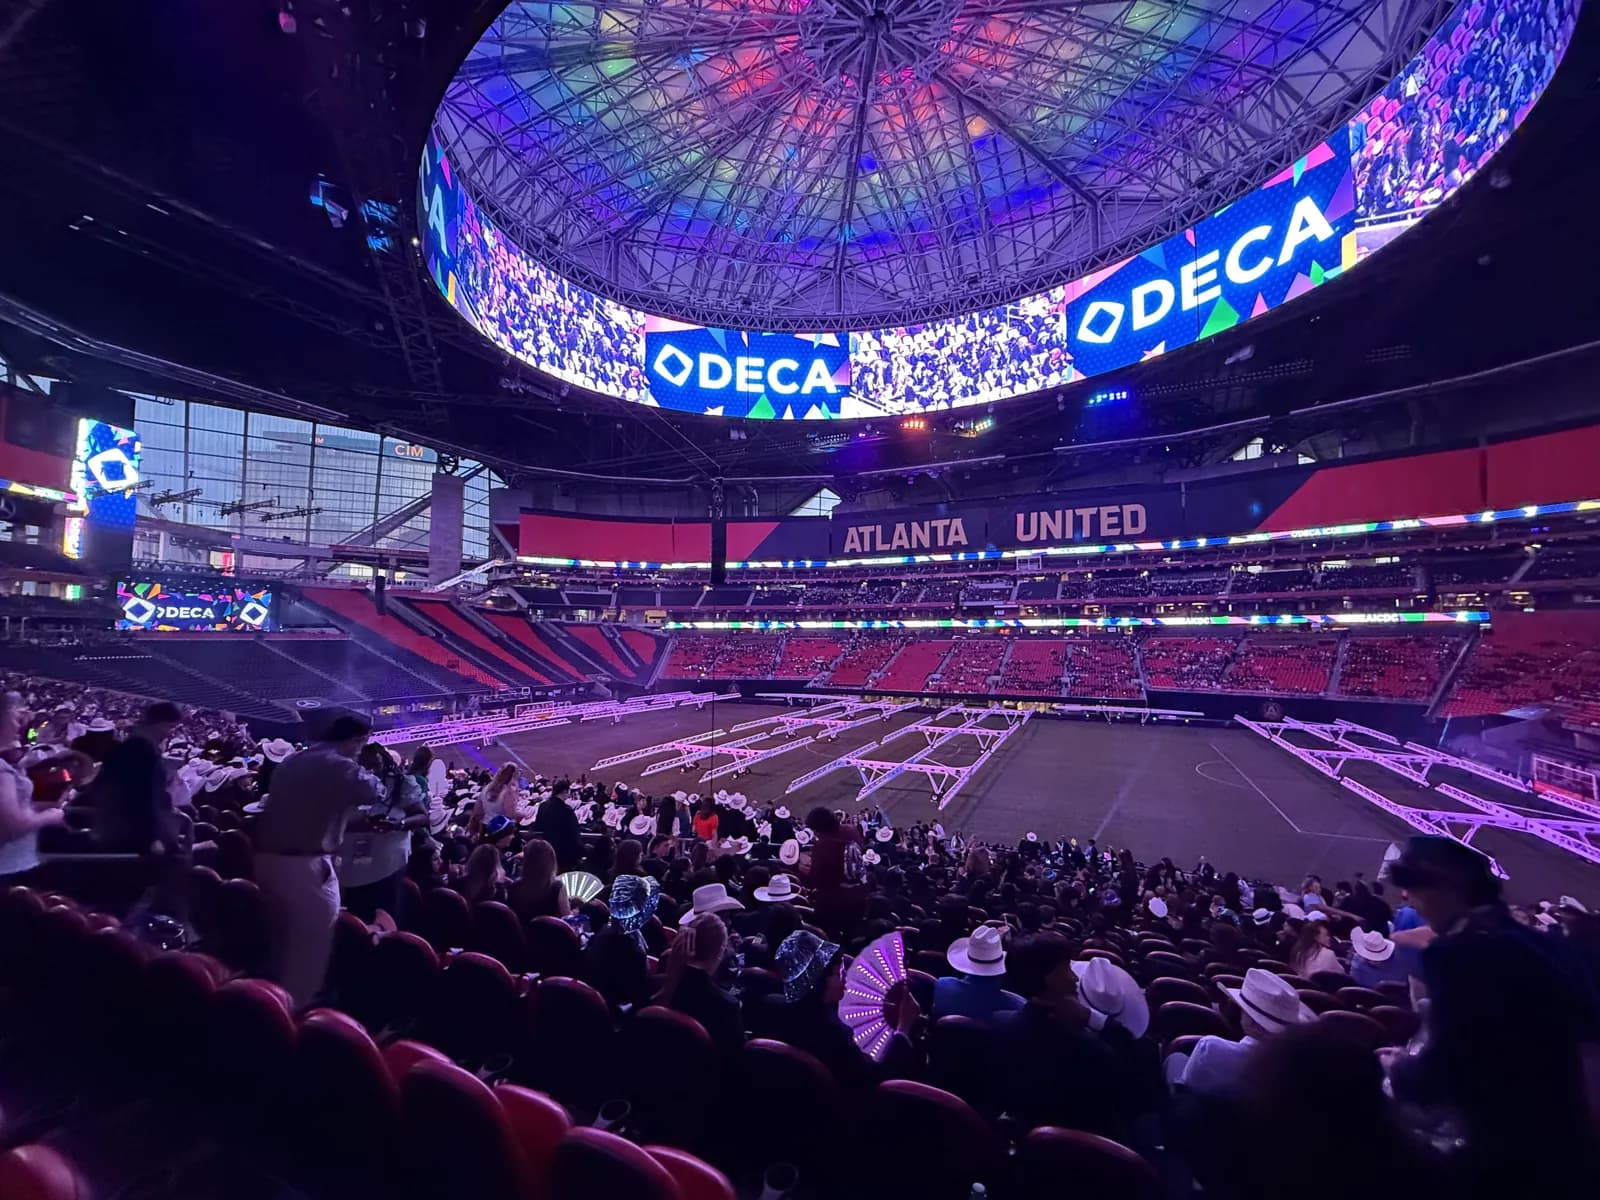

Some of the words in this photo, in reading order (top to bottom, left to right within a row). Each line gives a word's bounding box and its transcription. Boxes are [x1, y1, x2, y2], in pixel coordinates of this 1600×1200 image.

[1131, 196, 1335, 331] DECA
[699, 352, 837, 394] DECA
[394, 444, 424, 457] CIM
[843, 518, 969, 553] ATLANTA
[1016, 503, 1147, 542] UNITED
[166, 606, 215, 618] DECA
